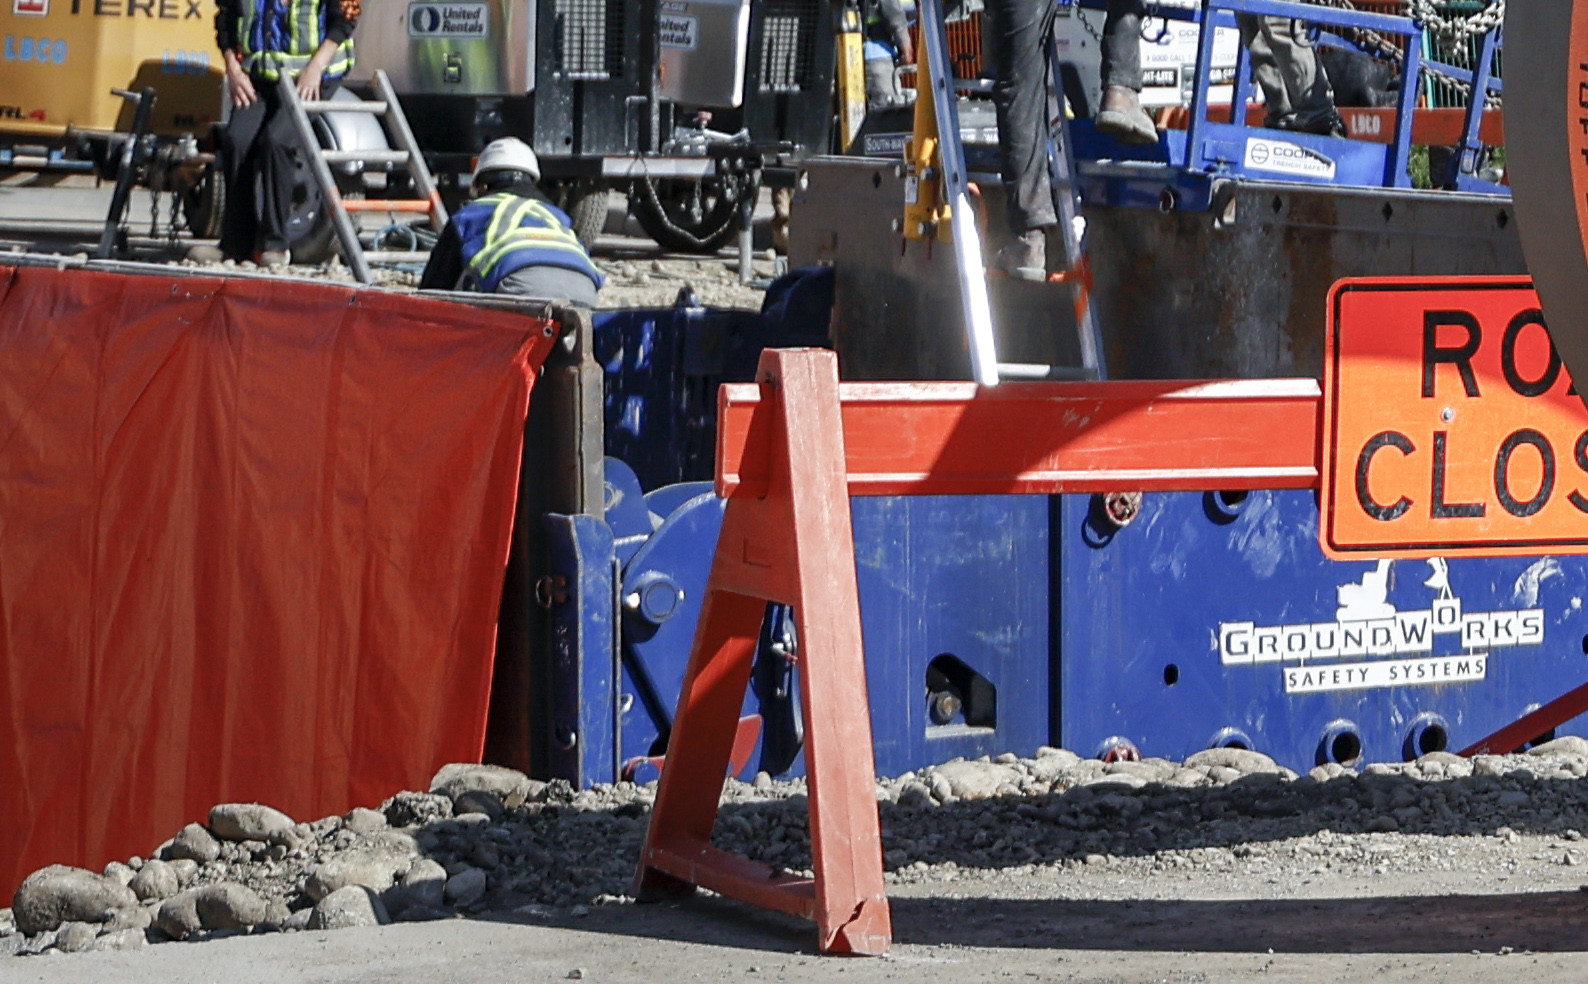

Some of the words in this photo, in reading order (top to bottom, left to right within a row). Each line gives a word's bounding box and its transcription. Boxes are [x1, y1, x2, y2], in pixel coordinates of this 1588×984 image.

[442, 6, 481, 19] United
[442, 19, 484, 33] Rentals
[660, 19, 689, 31] nited
[660, 31, 691, 44] ntals
[1272, 159, 1301, 169] TRENCH
[1422, 308, 1579, 398] RO
[1288, 667, 1369, 688] SAFETY
[1389, 658, 1483, 680] SYSTEMS
